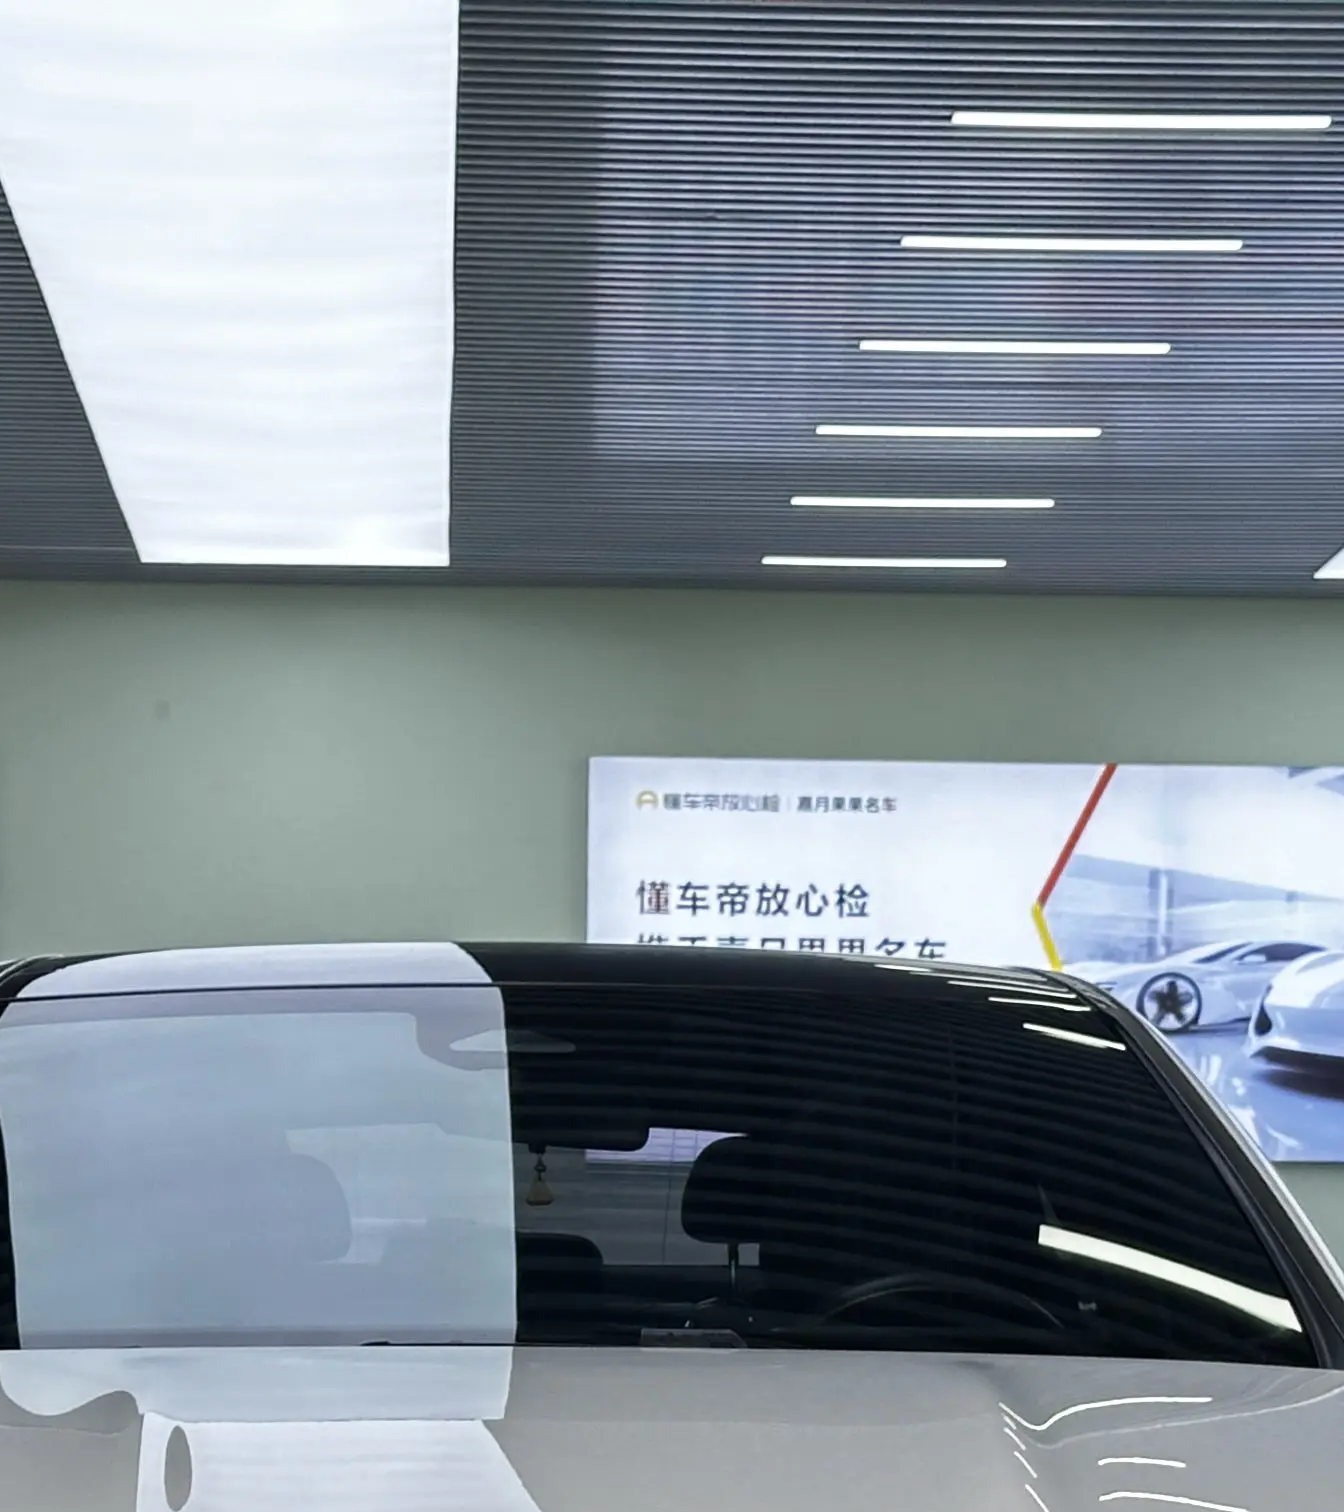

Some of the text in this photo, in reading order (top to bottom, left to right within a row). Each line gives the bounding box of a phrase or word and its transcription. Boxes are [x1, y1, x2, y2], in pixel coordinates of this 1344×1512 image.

[636, 879, 870, 918] 懂车帝放心检
